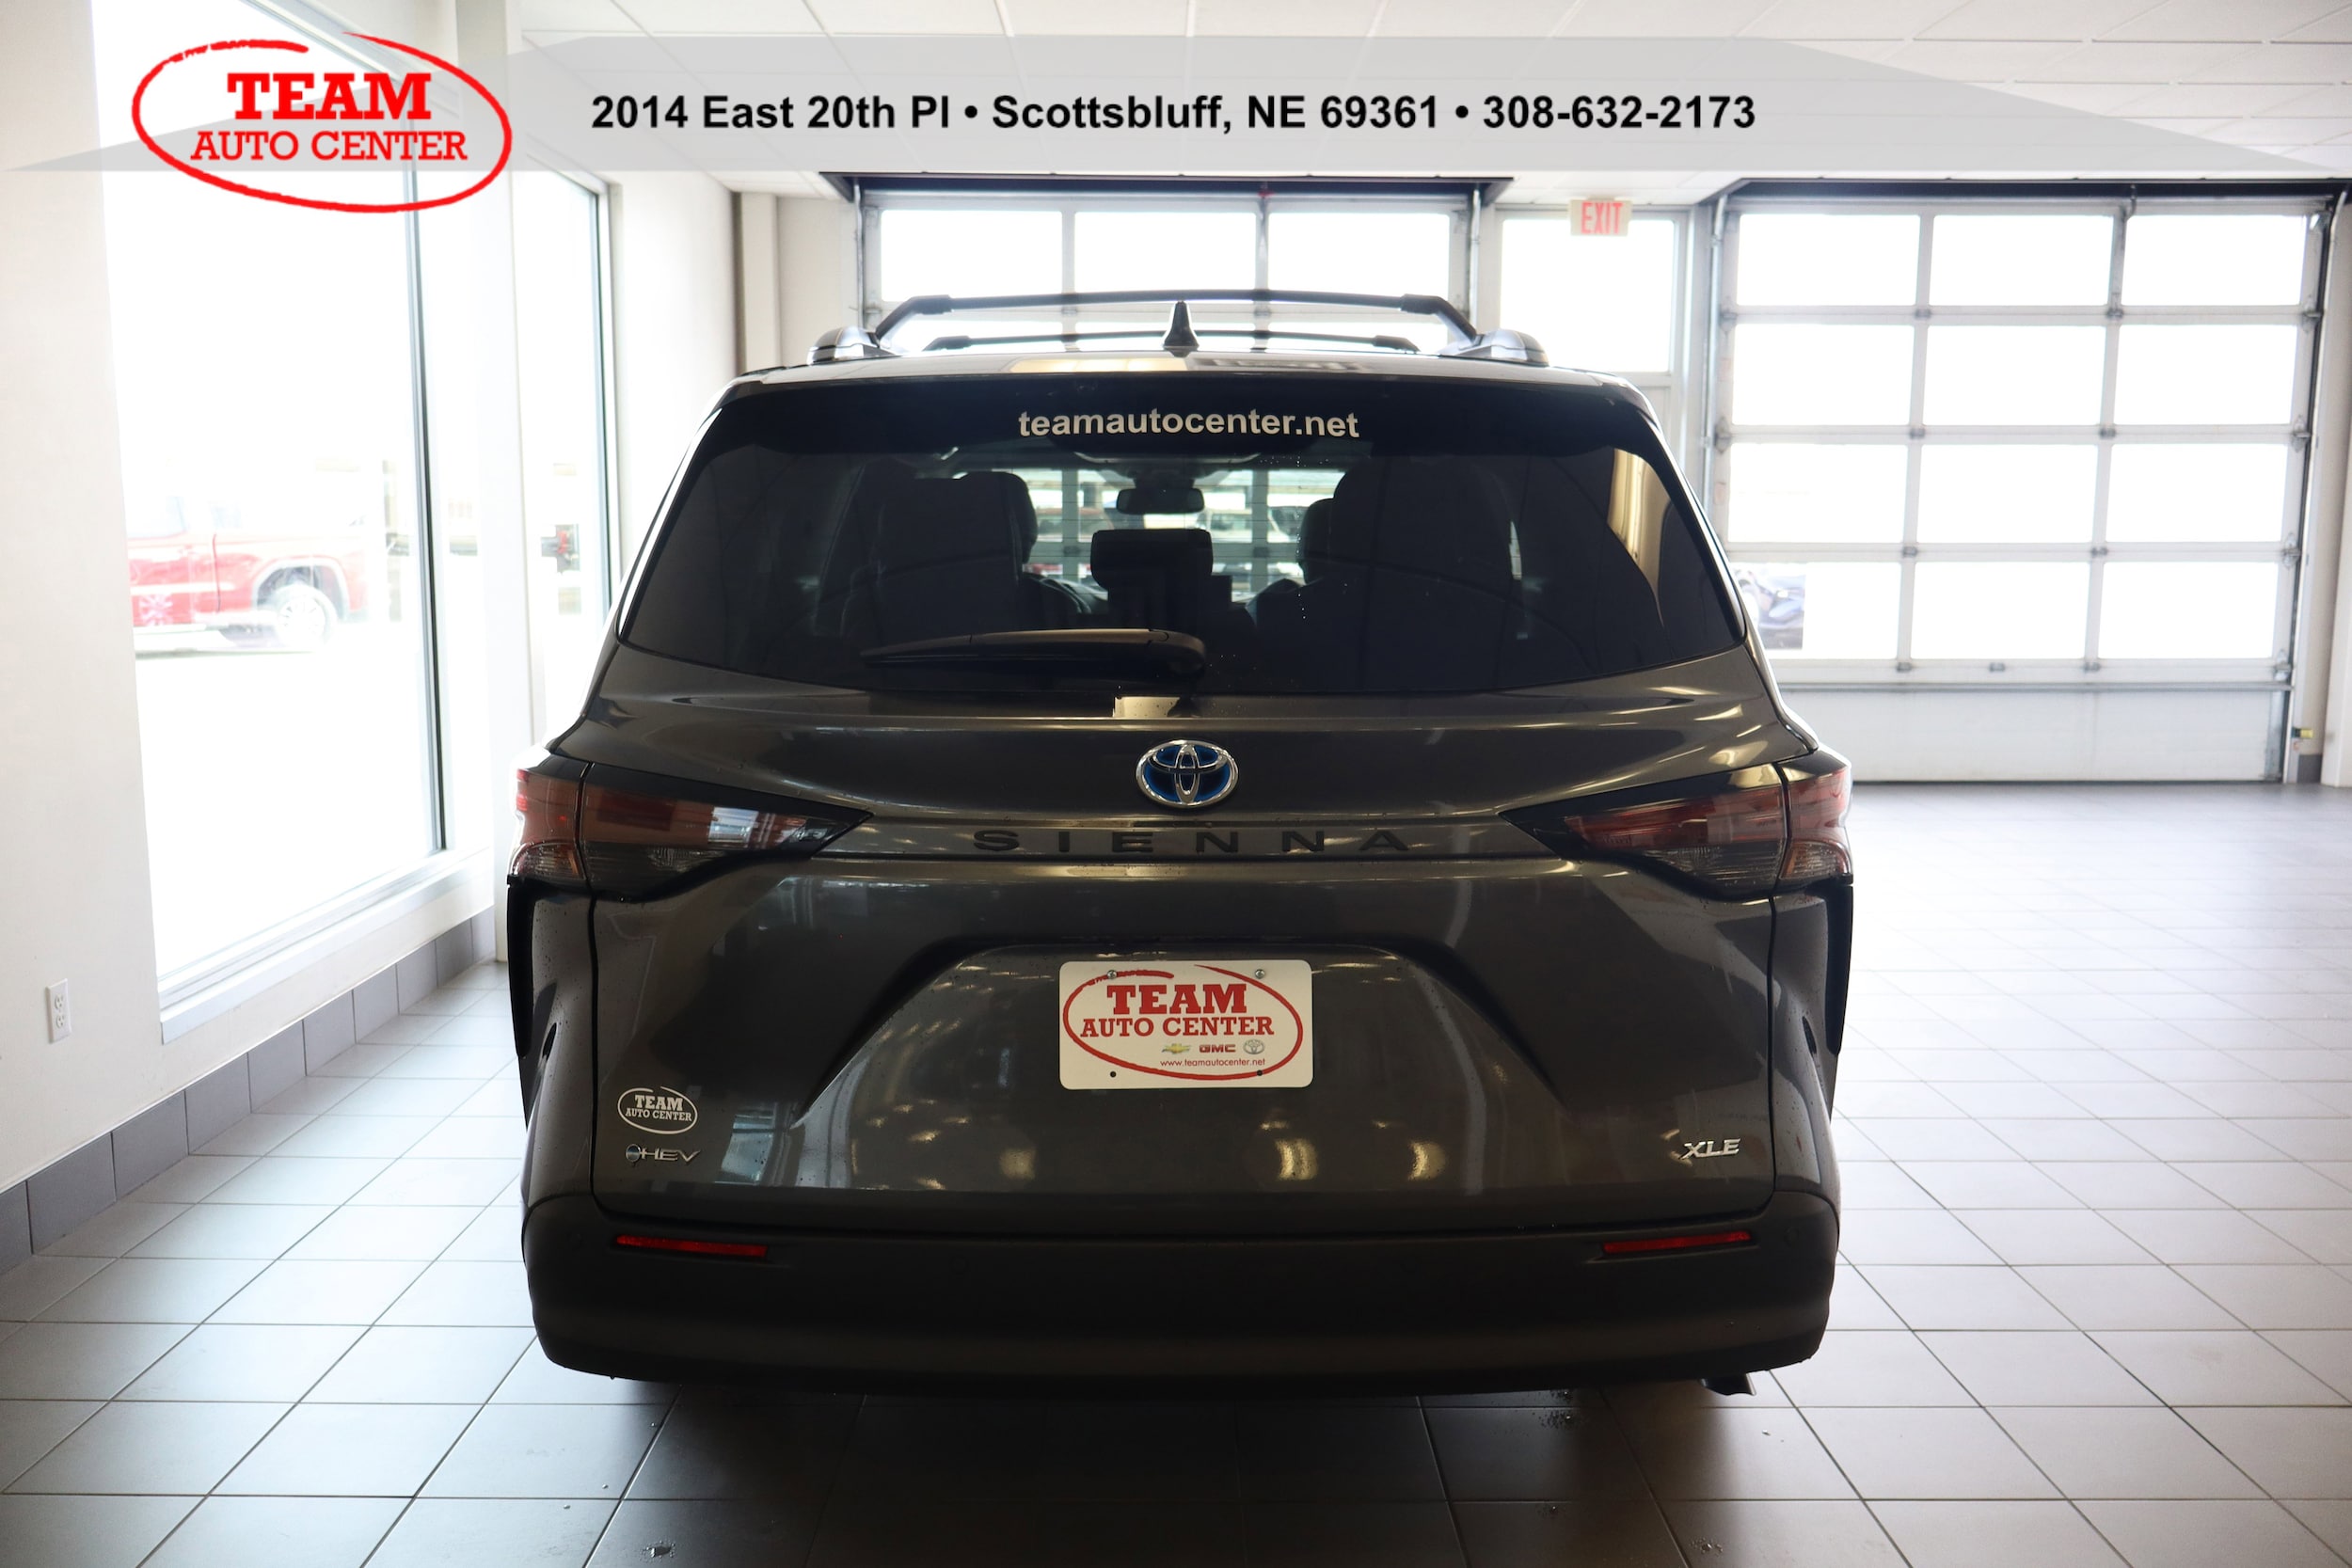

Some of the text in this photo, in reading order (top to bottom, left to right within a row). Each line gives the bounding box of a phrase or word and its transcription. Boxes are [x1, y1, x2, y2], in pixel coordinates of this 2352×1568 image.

[1581, 201, 1624, 234] EXIT
[1018, 408, 1359, 438] teamautocenter.net
[973, 829, 1409, 853] SIENNA
[1106, 983, 1248, 1015] TEAM
[1080, 1016, 1275, 1037] AUTO CENTER
[1200, 1044, 1236, 1053] GMC
[1160, 1058, 1265, 1067] www.teamautocenter.net
[635, 1095, 683, 1111] TEAM
[626, 1108, 691, 1121] AUTO CENTER
[1680, 1138, 1740, 1160] XLE
